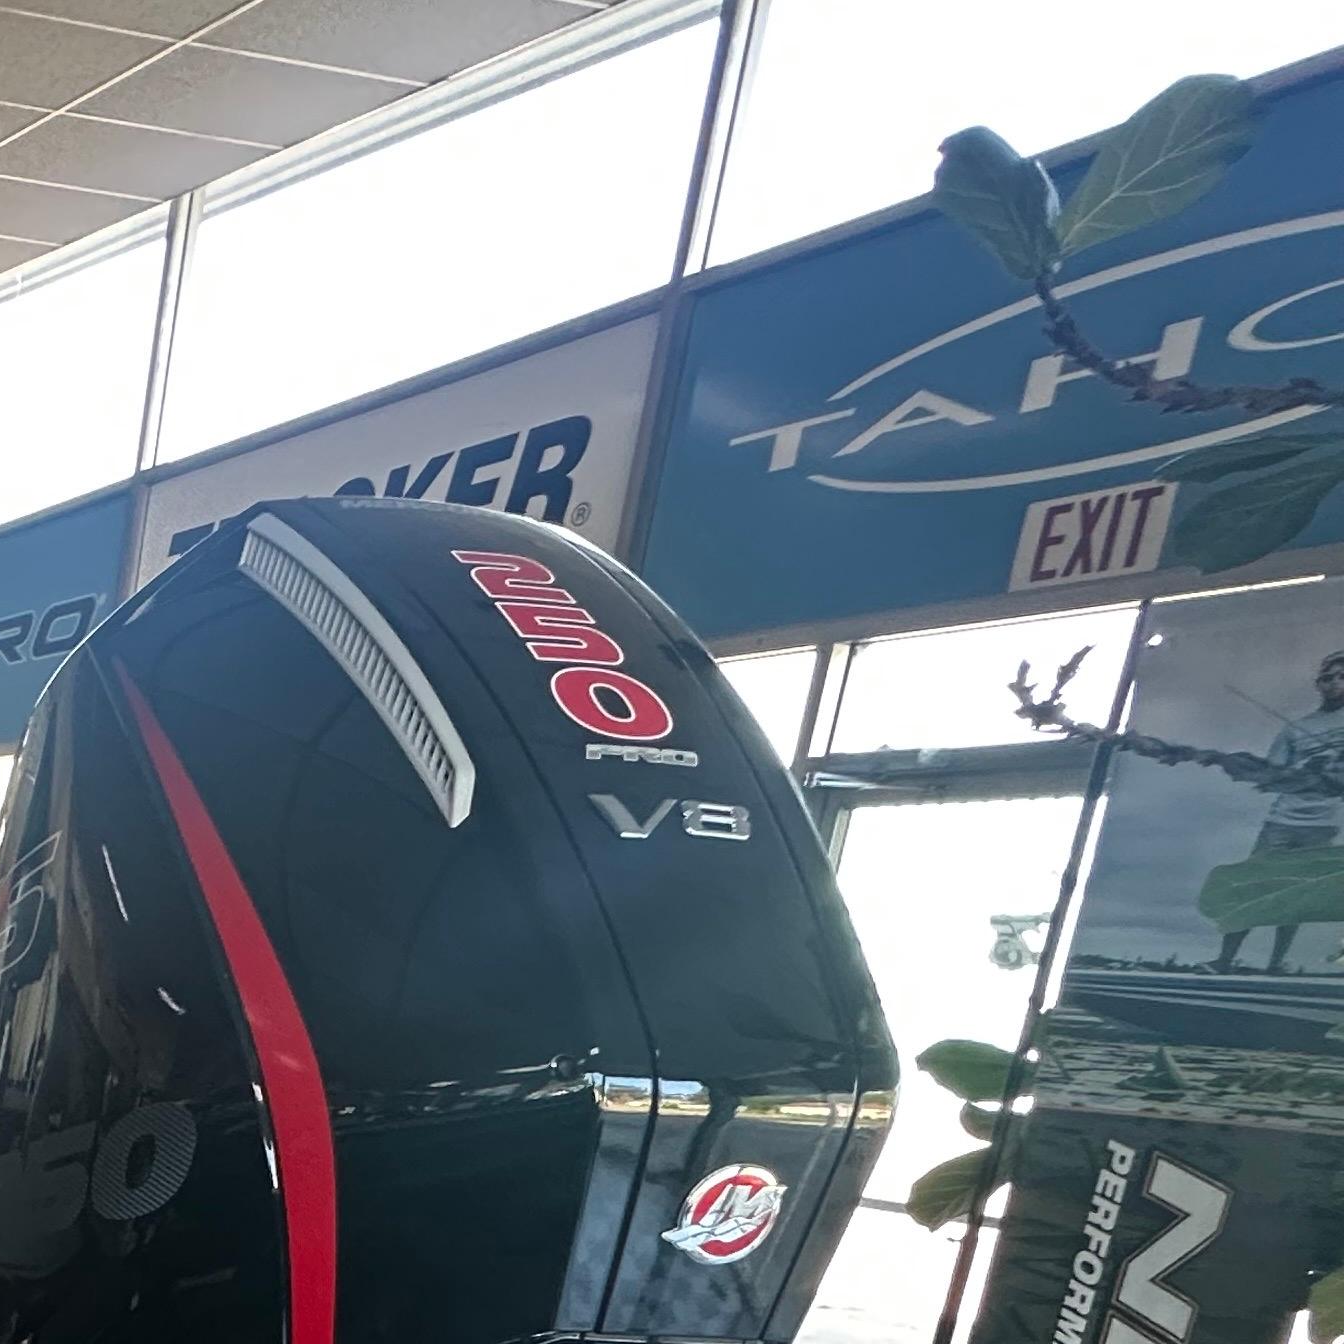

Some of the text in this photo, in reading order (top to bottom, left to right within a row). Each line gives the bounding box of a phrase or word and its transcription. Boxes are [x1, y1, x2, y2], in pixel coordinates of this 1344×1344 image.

[1028, 485, 1166, 583] EXIT
[450, 549, 673, 741] 250
[585, 743, 699, 768] PRO
[587, 793, 751, 841] V8
